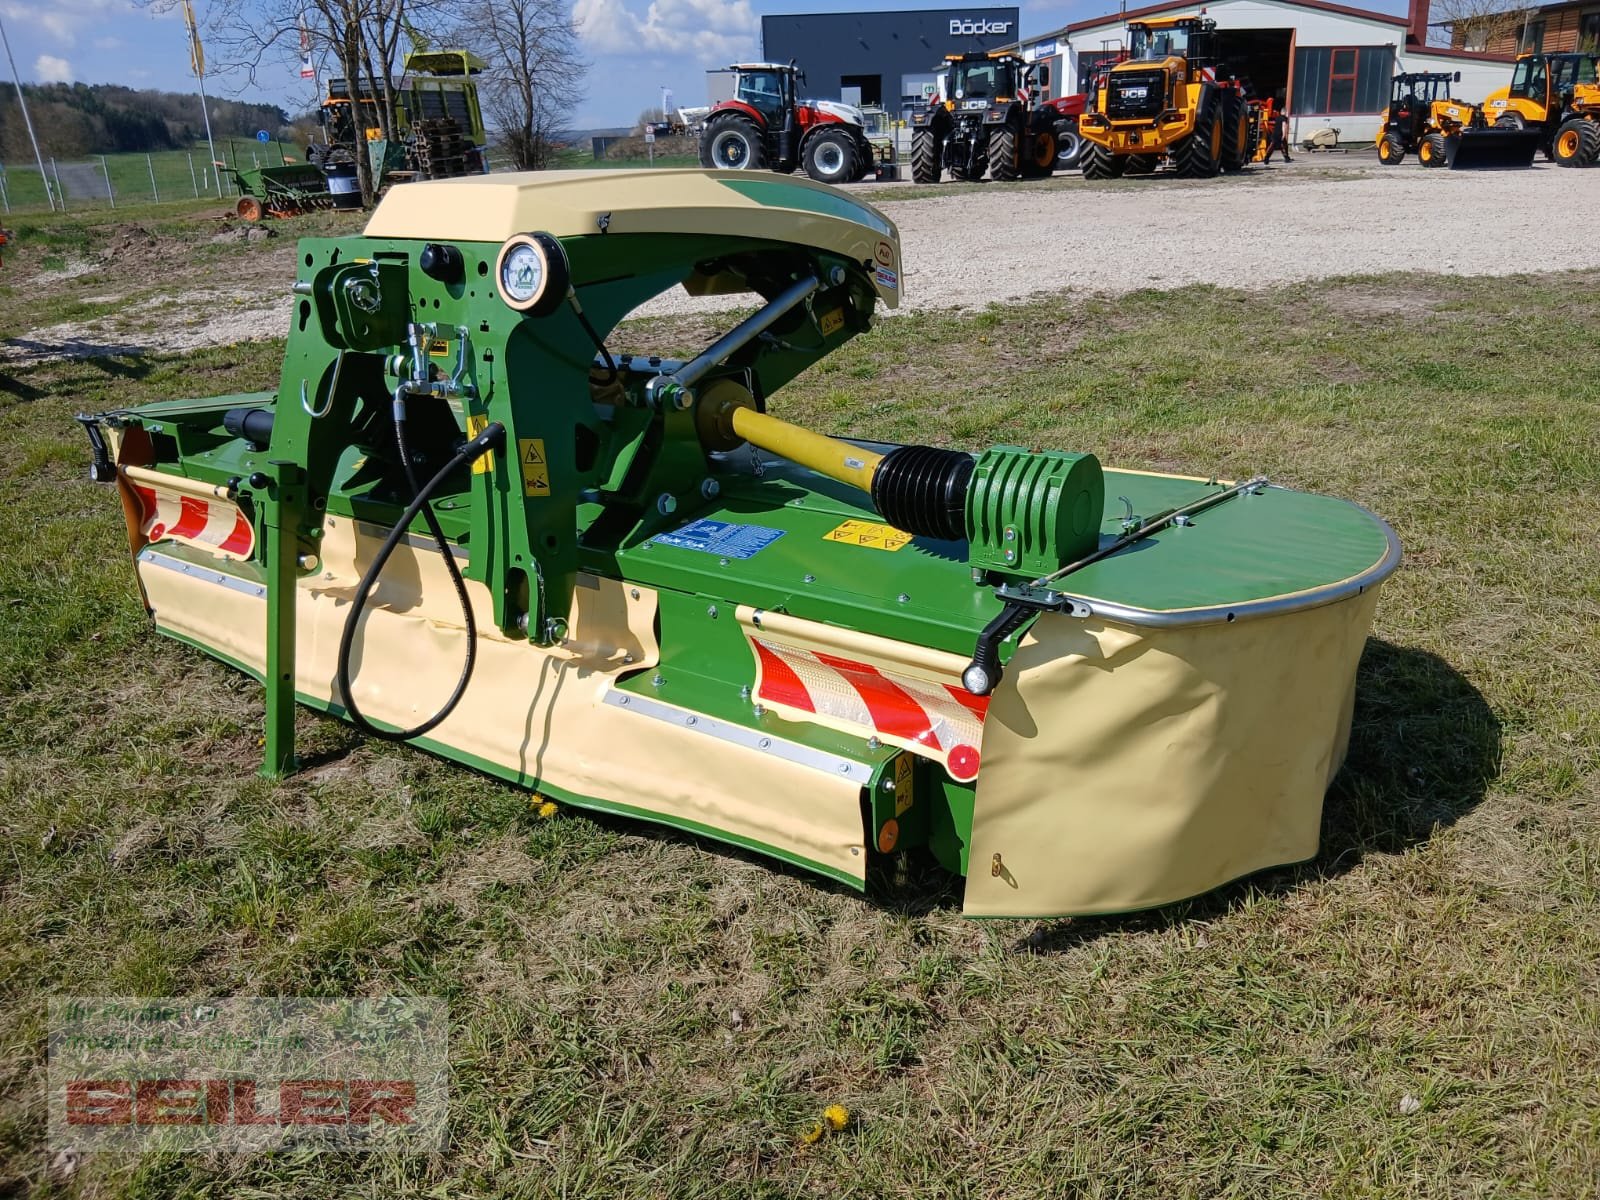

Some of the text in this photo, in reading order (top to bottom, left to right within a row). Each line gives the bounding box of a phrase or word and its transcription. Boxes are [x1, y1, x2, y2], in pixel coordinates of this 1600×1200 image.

[949, 18, 1013, 35] Böcker
[1120, 89, 1148, 99] JCB
[961, 100, 988, 110] JCB
